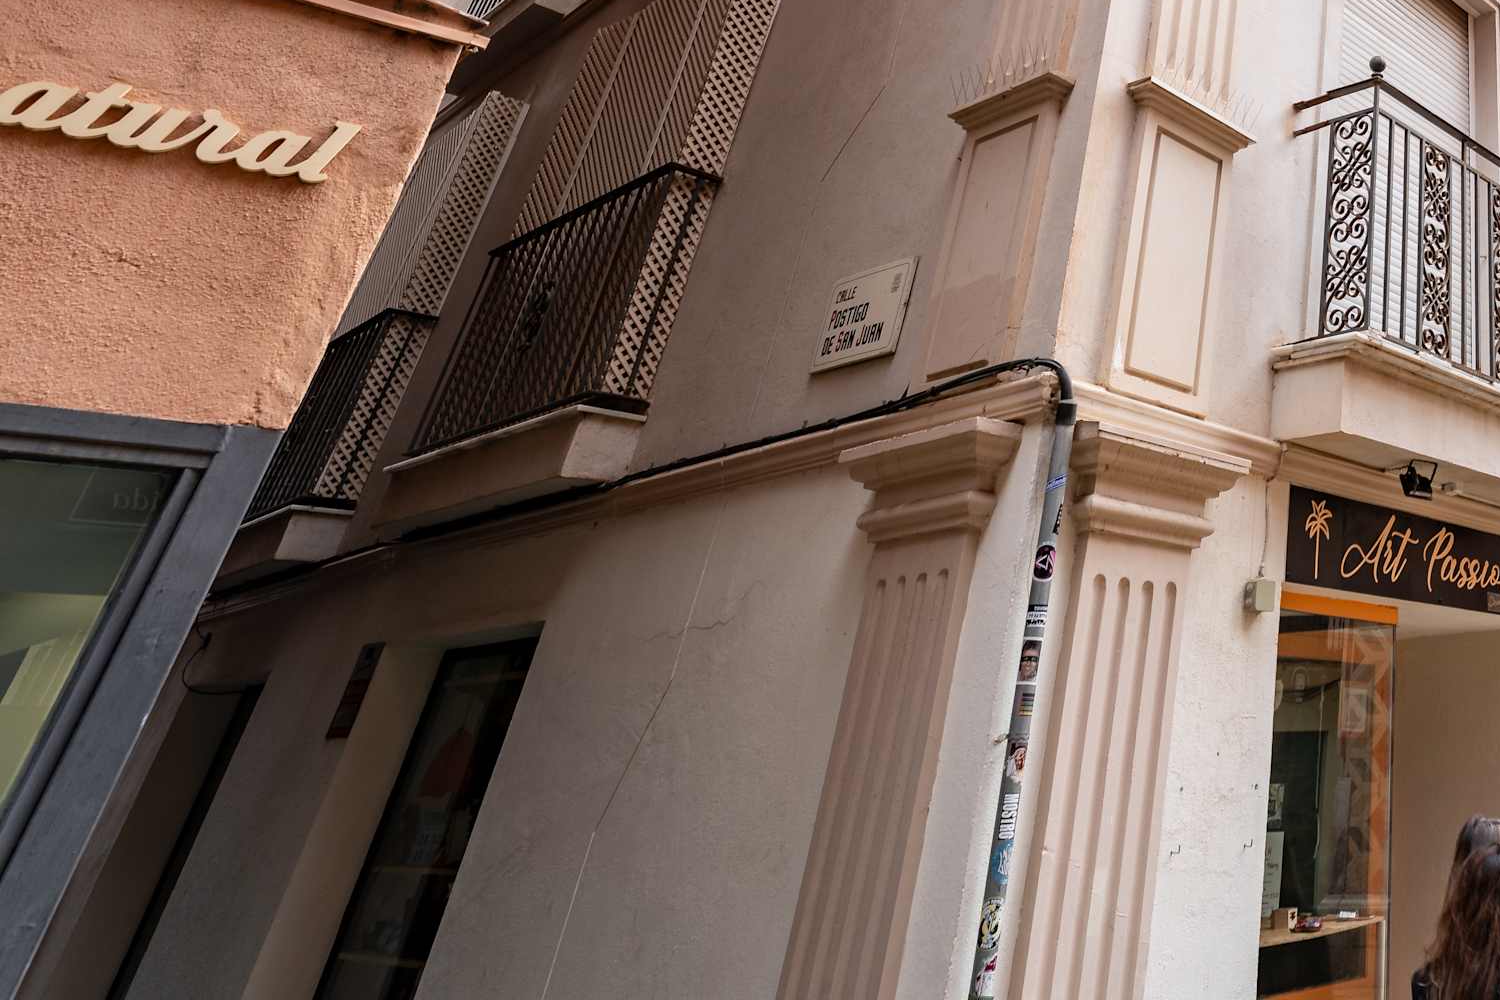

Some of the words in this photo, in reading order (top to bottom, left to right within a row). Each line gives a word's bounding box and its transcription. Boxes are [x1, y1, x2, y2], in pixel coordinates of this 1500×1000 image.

[835, 286, 858, 304] CALLE
[828, 302, 870, 331] POSTIGO
[821, 335, 835, 356] DE
[834, 329, 856, 353] SAN
[855, 322, 884, 347] JUAN
[1340, 513, 1419, 584] Art
